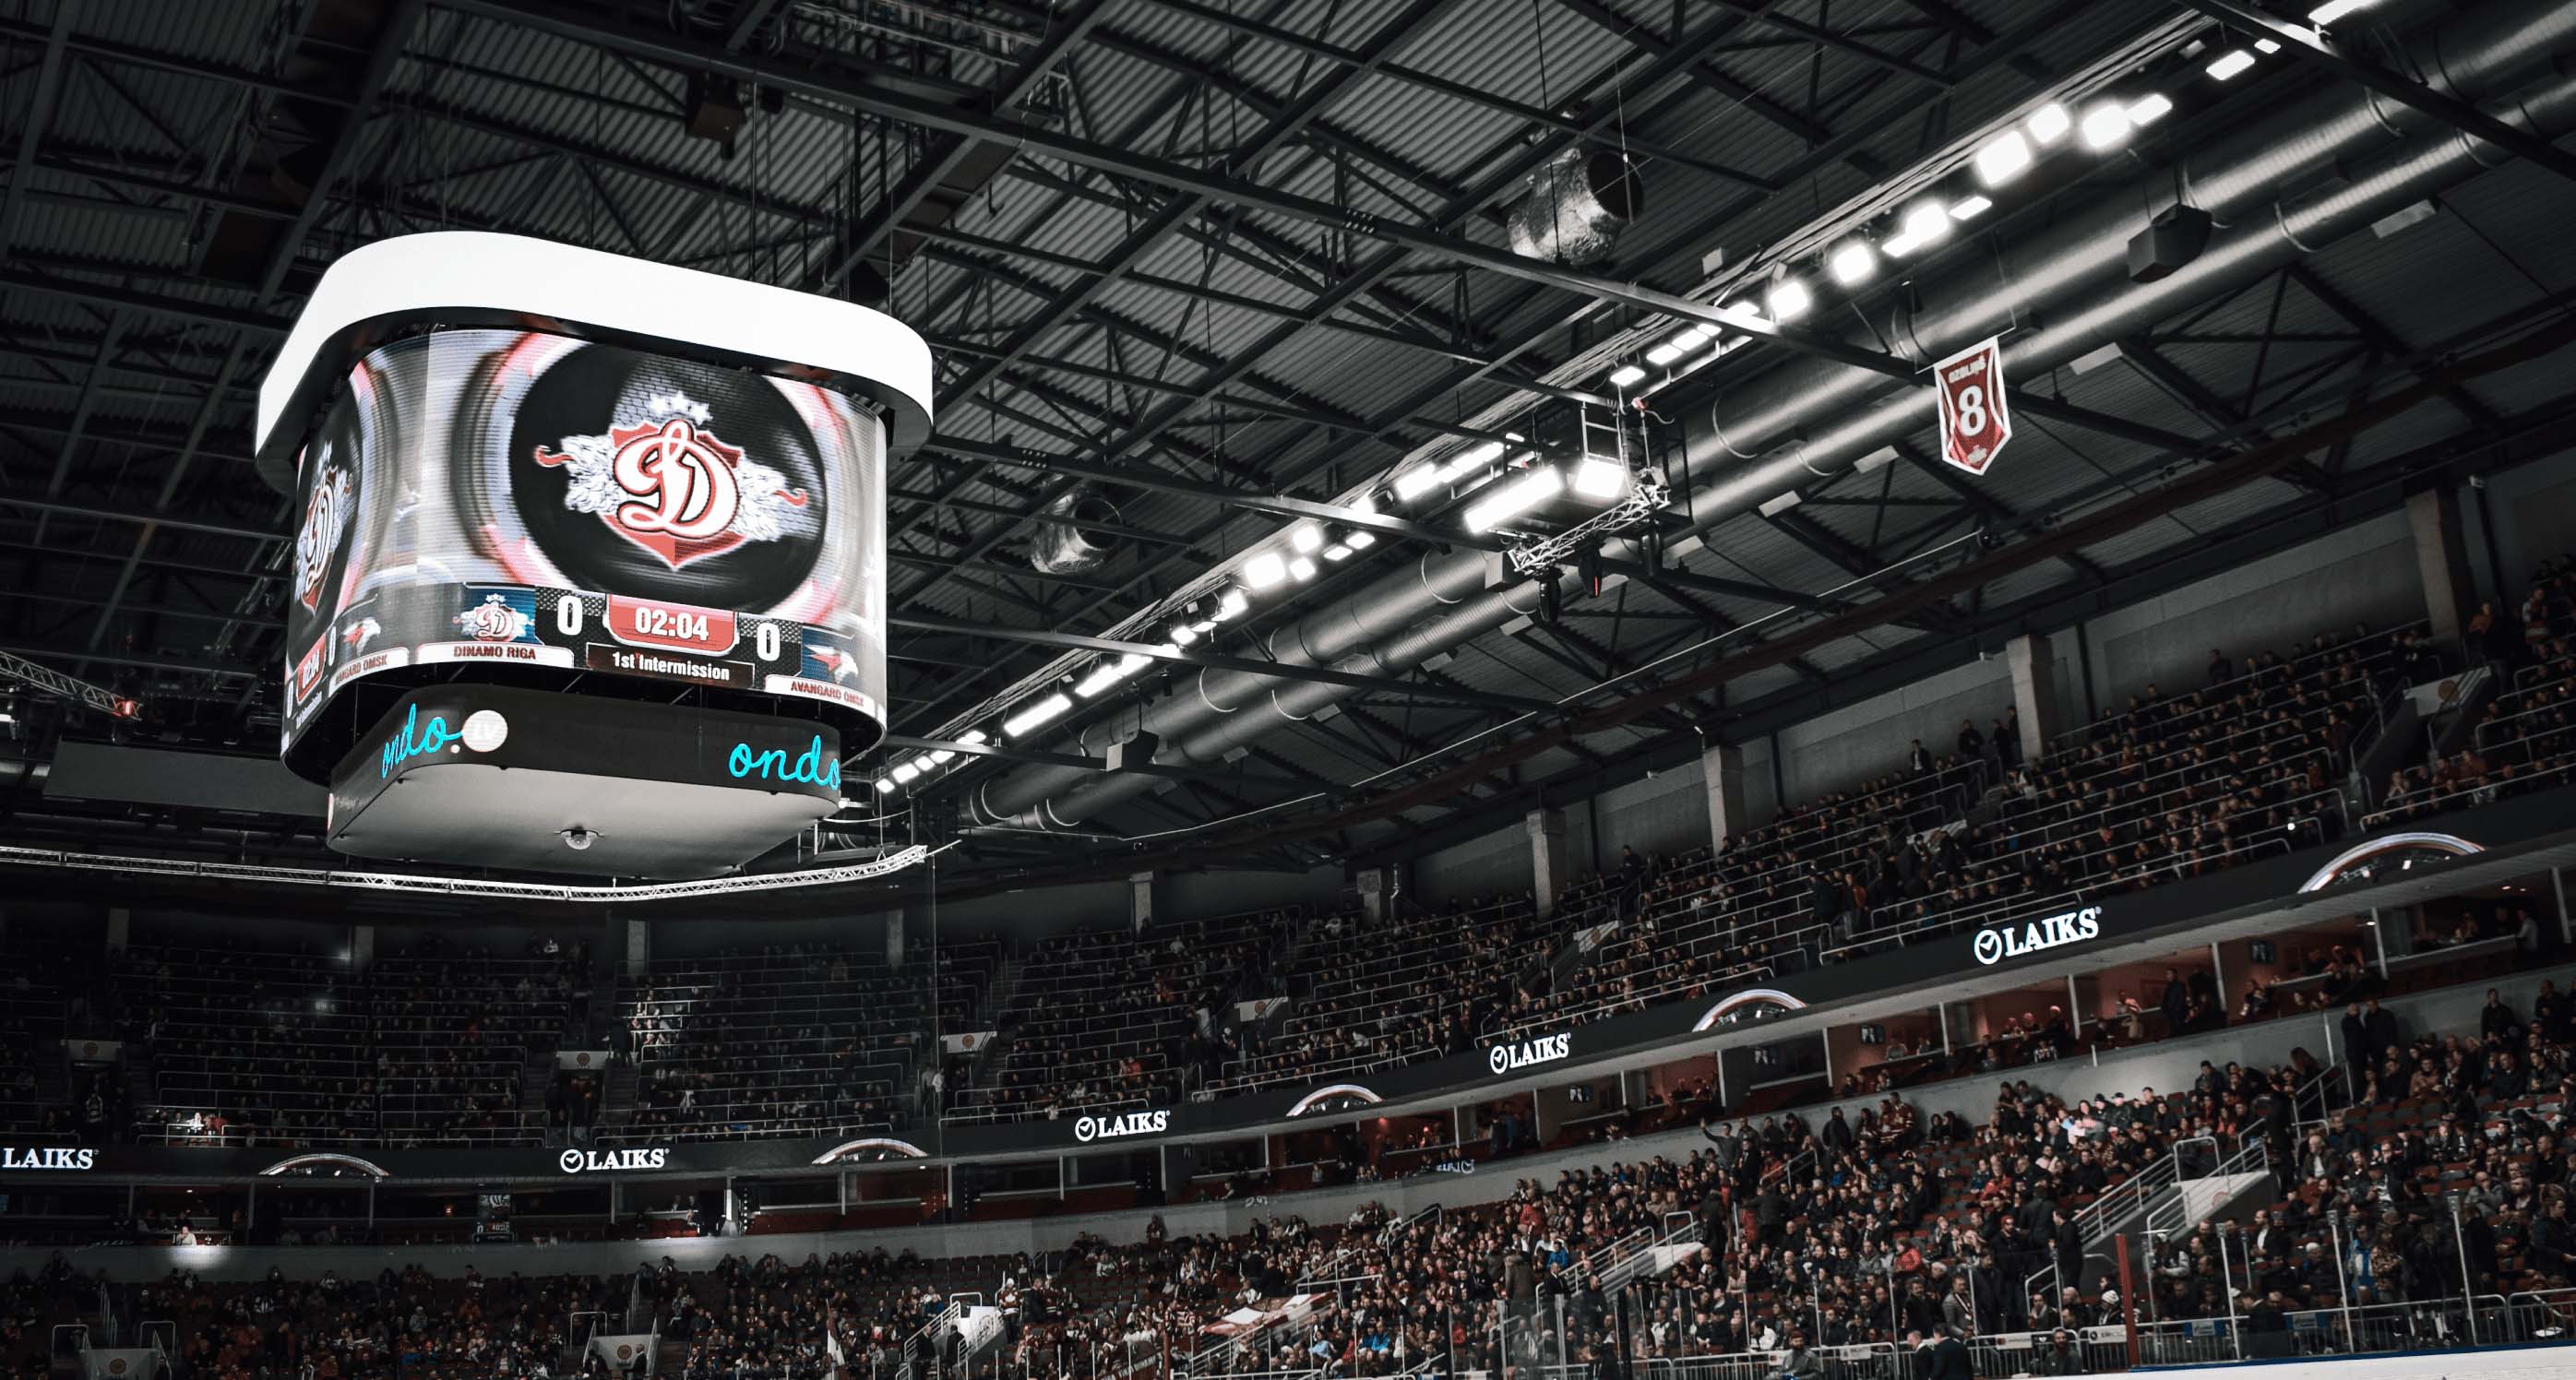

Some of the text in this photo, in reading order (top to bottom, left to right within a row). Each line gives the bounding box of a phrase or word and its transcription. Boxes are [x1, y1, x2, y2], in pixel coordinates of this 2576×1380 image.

[1959, 385, 1986, 436] 8
[557, 595, 583, 636] 0
[635, 607, 710, 641] 02:04
[454, 647, 536, 660] DINAMO RIGA
[757, 623, 781, 661] 0
[364, 655, 388, 670] OMSK
[613, 652, 730, 681] 1st Intermission
[791, 681, 841, 699] AVANGARD
